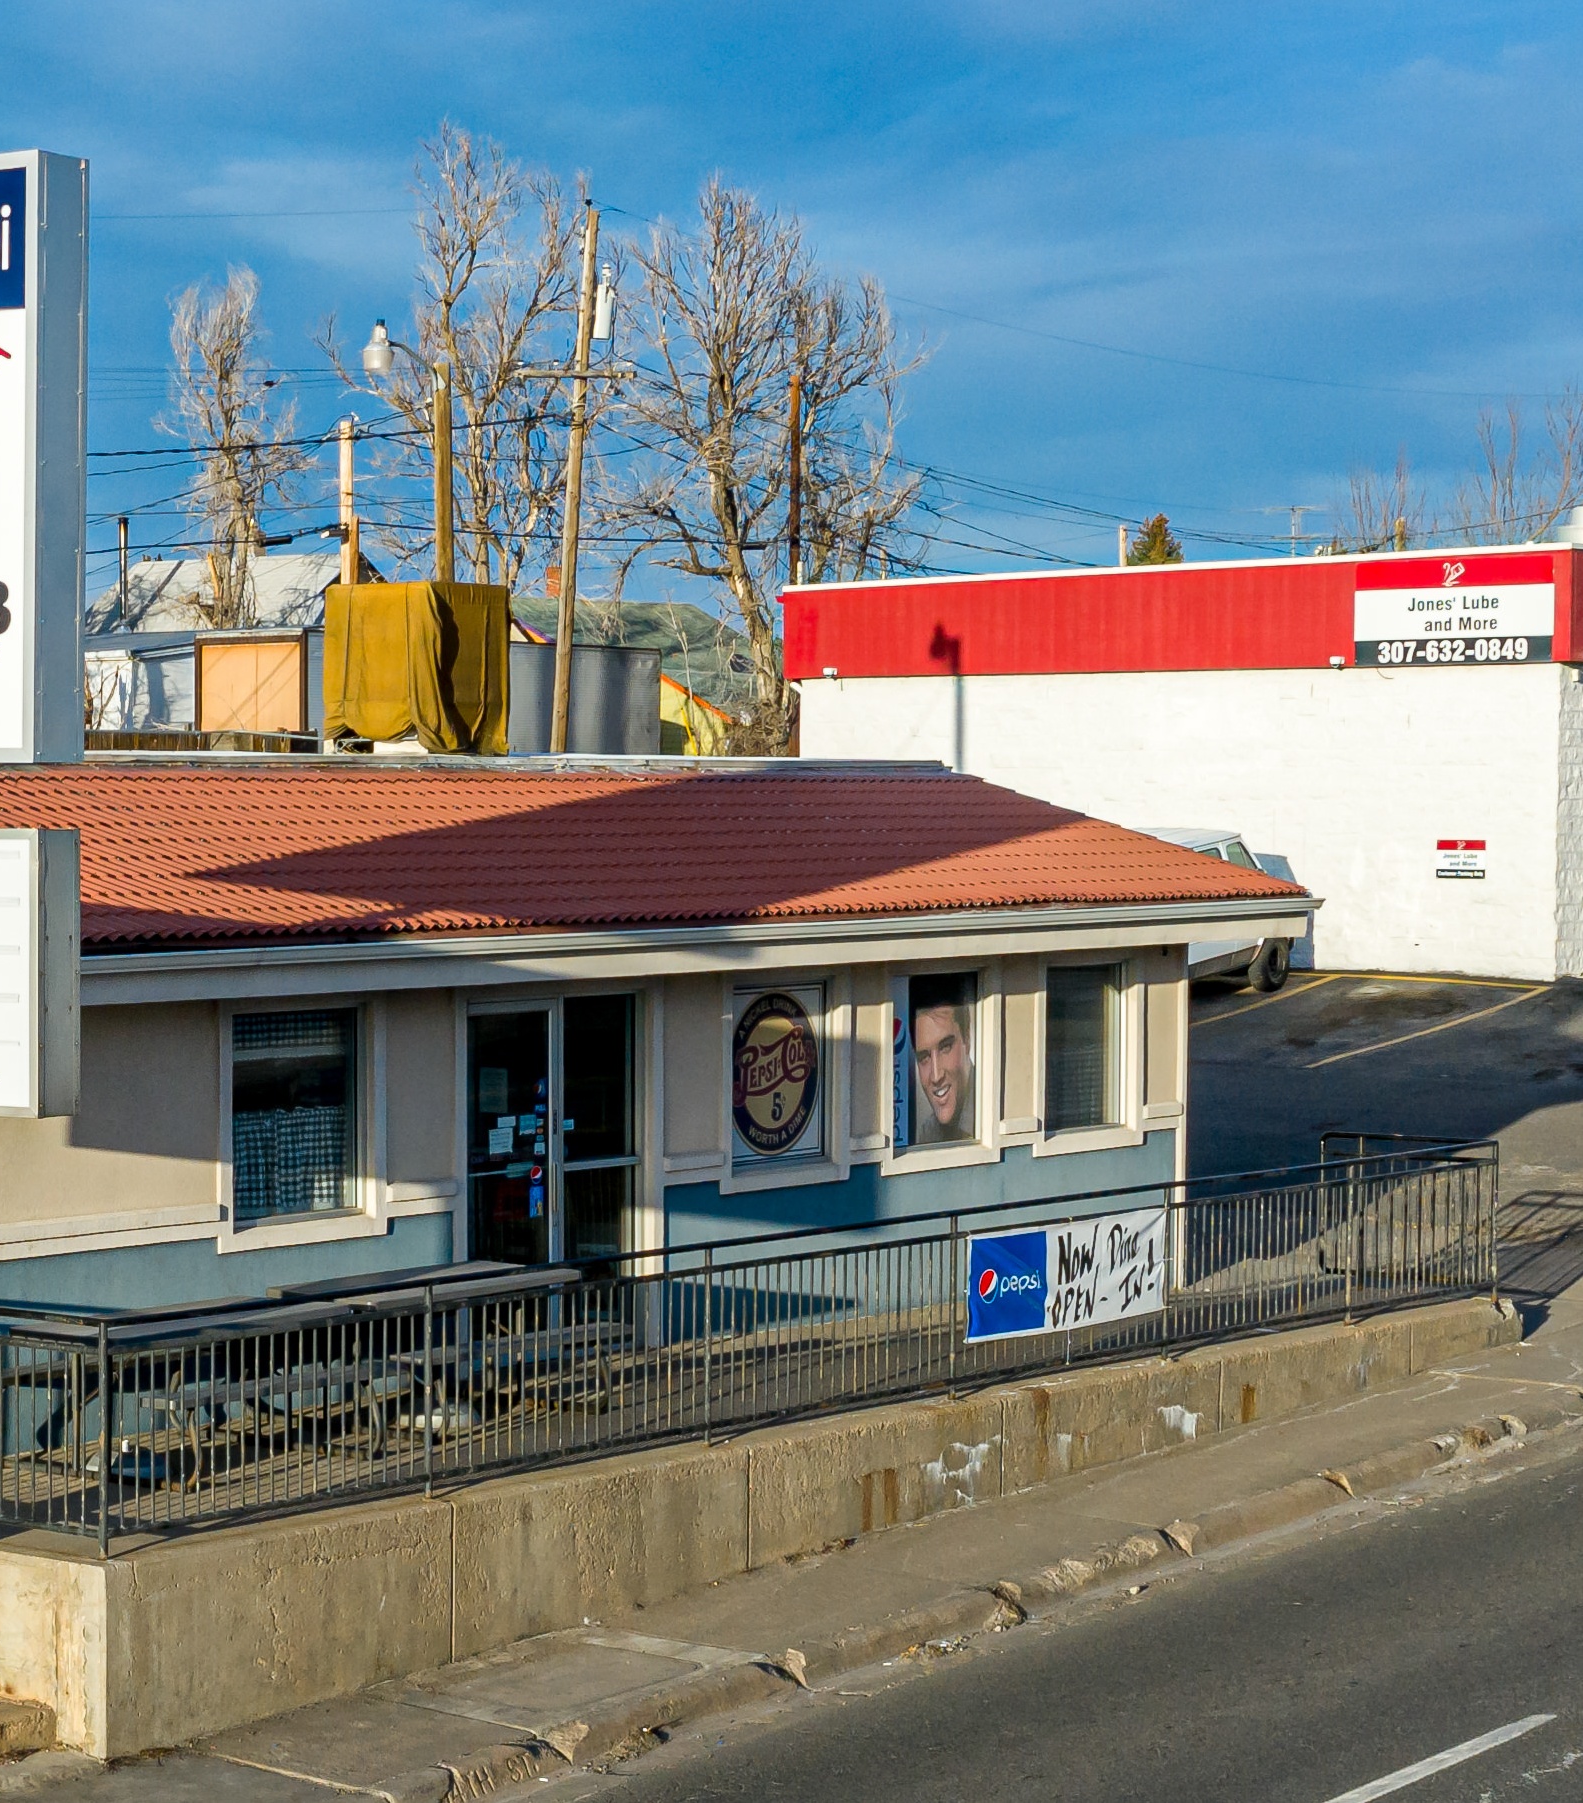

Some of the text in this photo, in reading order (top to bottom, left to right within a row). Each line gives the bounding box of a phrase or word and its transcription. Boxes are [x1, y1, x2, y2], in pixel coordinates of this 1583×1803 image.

[1408, 595, 1499, 612] Jones' Lube
[1424, 617, 1498, 632] and More
[1377, 638, 1529, 664] 307-632-0849
[749, 1106, 806, 1145] WORTH A DIME
[999, 1269, 1042, 1298] pepsi
